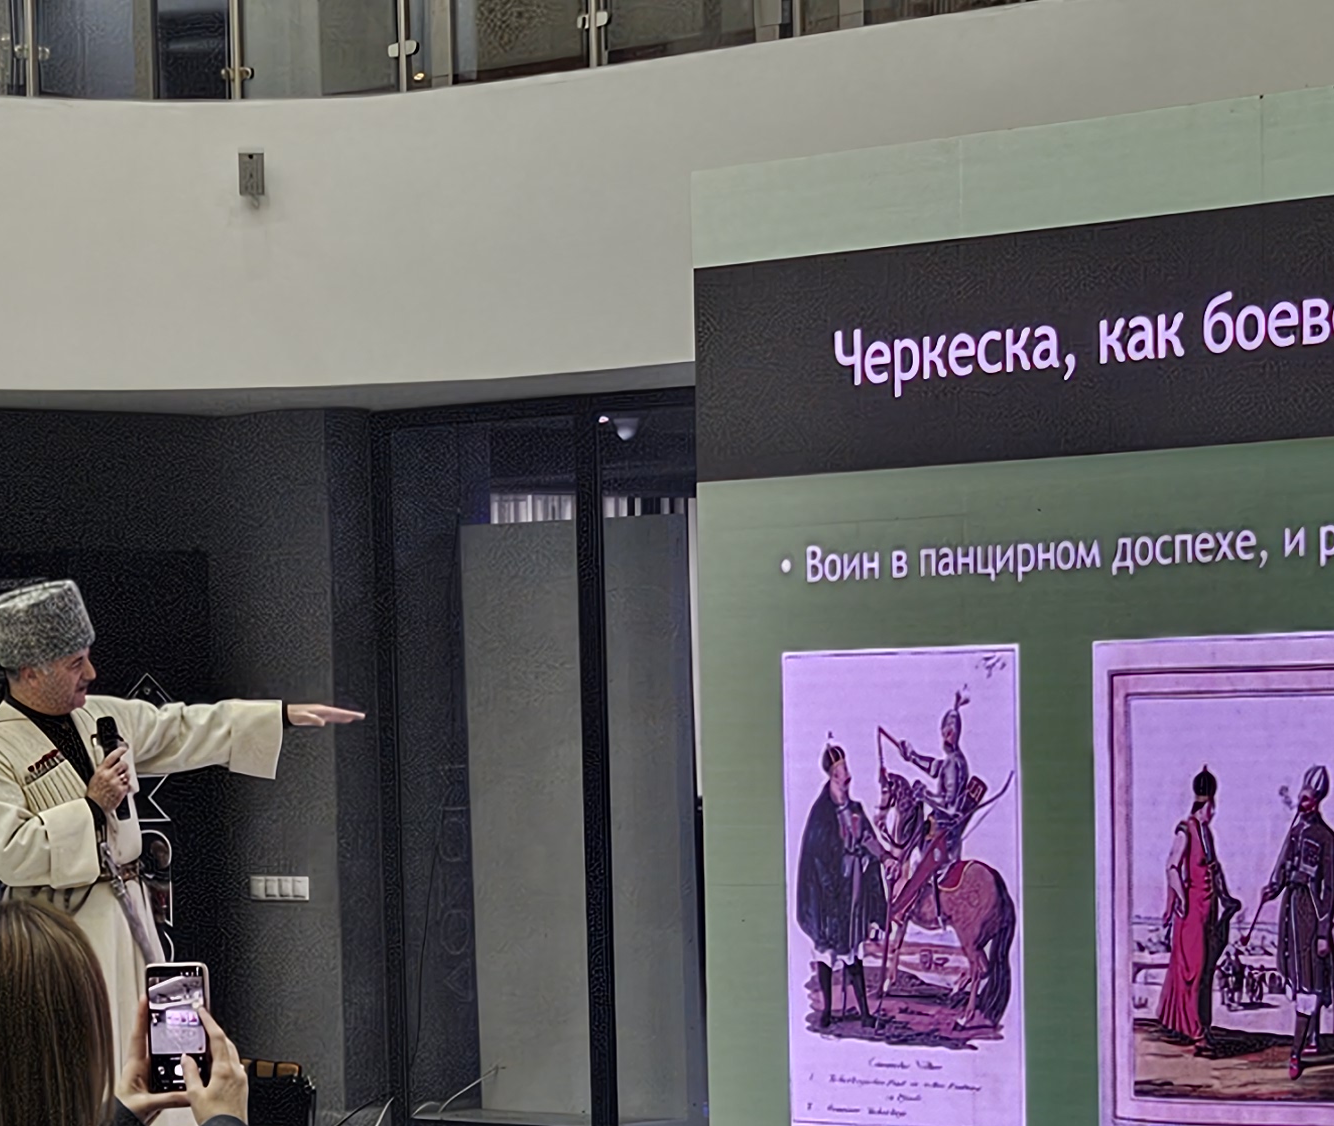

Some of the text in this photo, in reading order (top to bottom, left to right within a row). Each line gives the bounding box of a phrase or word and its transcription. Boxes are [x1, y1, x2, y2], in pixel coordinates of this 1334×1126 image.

[833, 325, 1078, 398] Черкеска,
[1097, 310, 1185, 365] как
[804, 544, 881, 583] Воин
[891, 548, 908, 579] в
[919, 538, 1102, 583] панцирном
[1111, 529, 1269, 575] доспехе,
[1283, 525, 1307, 557] и
